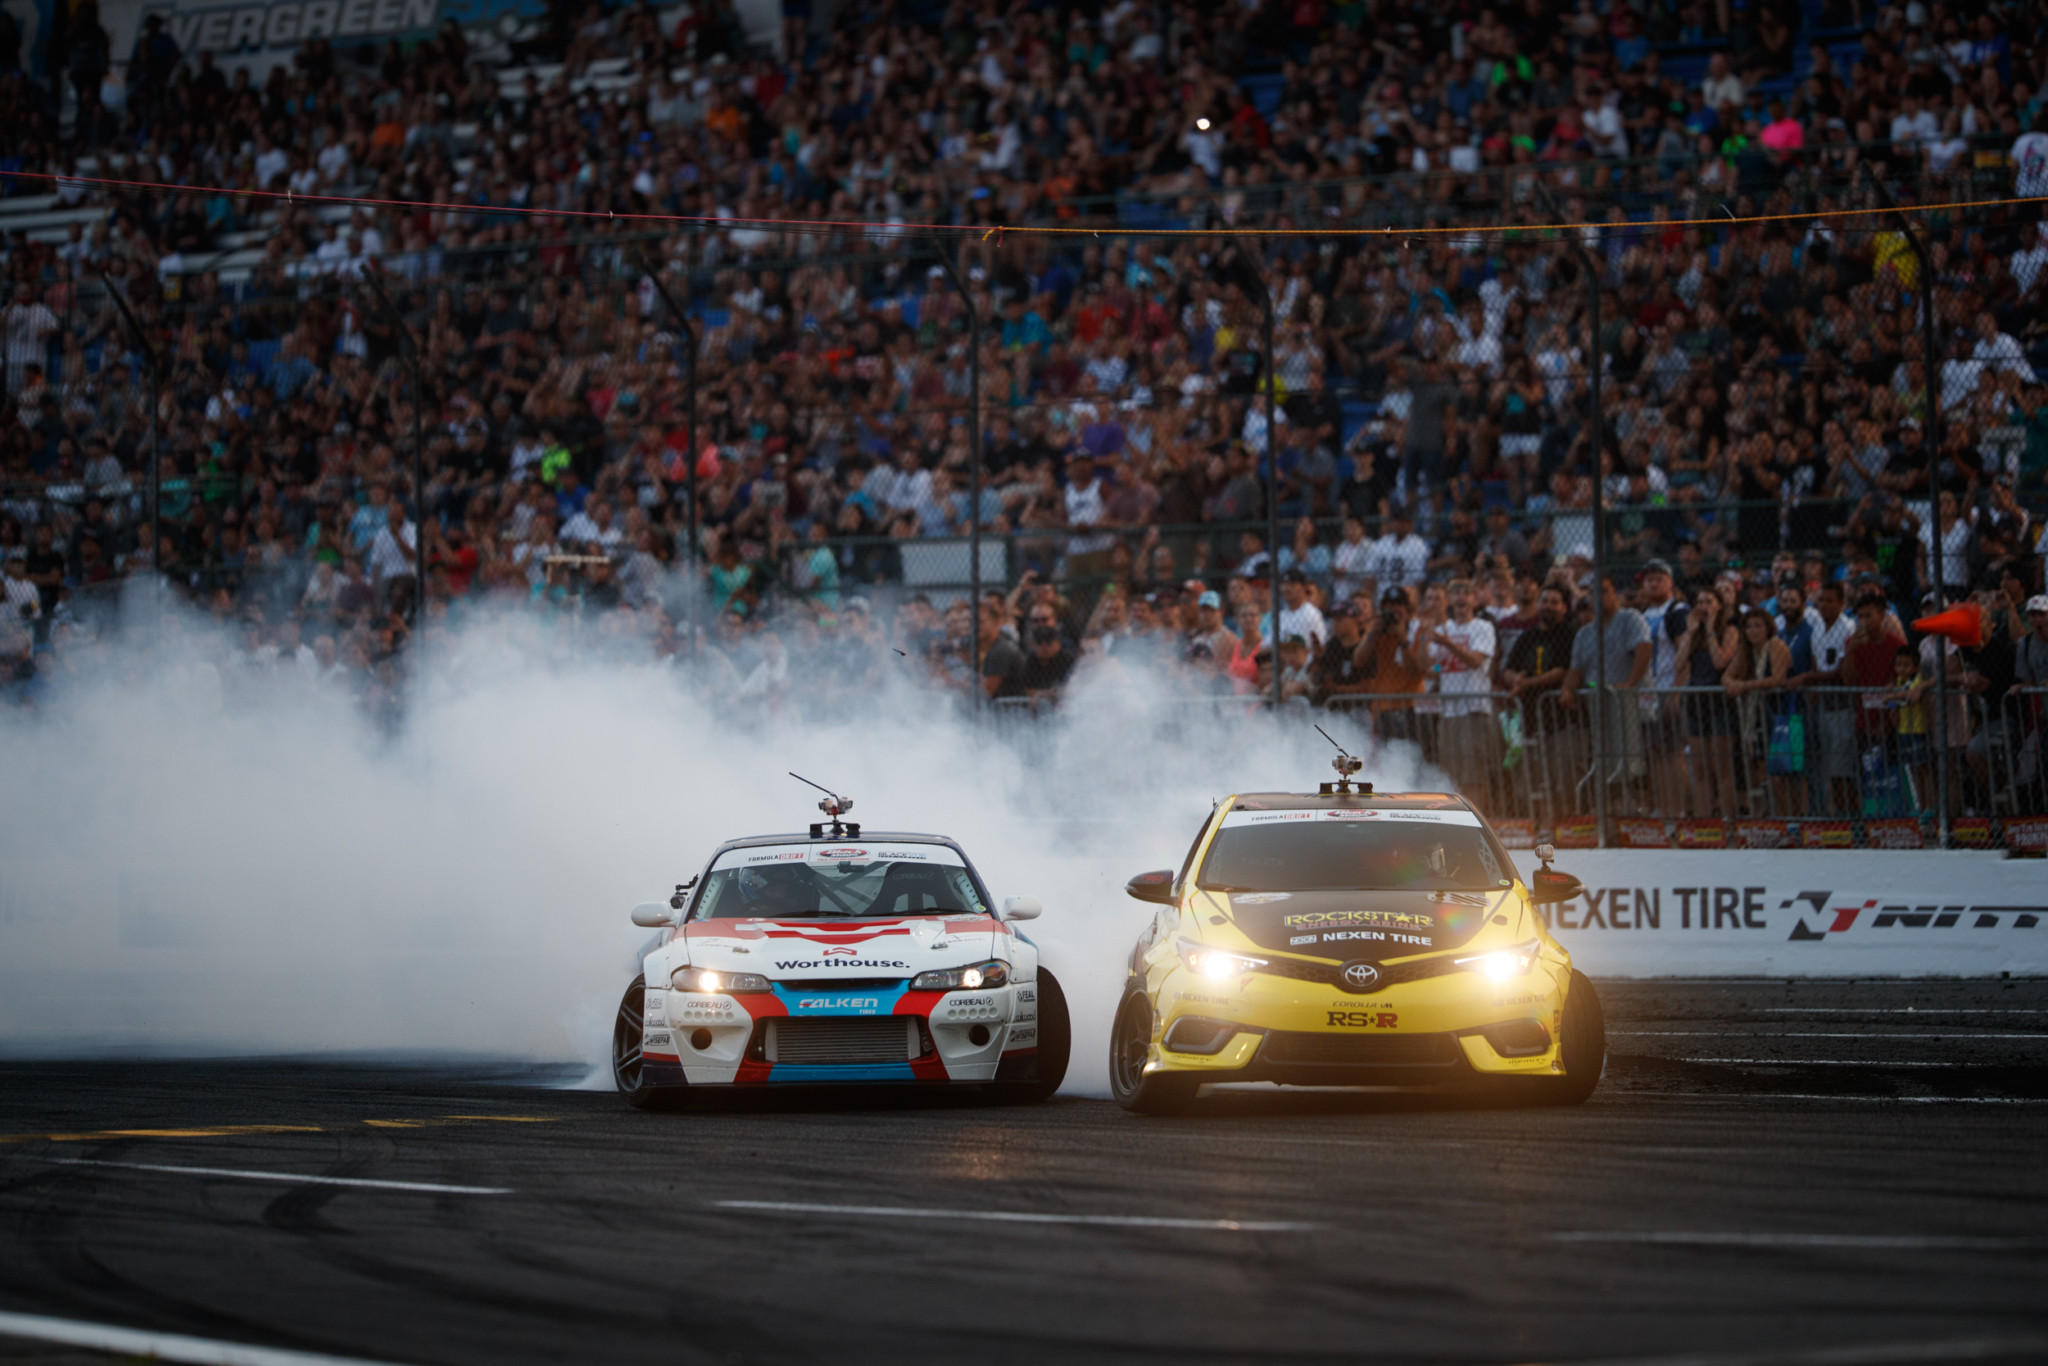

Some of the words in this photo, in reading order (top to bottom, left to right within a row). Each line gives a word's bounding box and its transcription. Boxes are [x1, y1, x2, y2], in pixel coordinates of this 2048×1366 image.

[1536, 887, 1660, 930] EXEN
[1672, 886, 1767, 930] TIRE
[1297, 919, 1363, 930] ENERGY
[1368, 919, 1419, 930] DRINK
[1323, 931, 1385, 942] NEXEN
[1389, 933, 1433, 946] TIRE
[1022, 990, 1035, 999] FEAL
[687, 1000, 723, 1009] CORBEAU
[798, 997, 879, 1009] FALKEN
[949, 997, 986, 1007] CORBEAU
